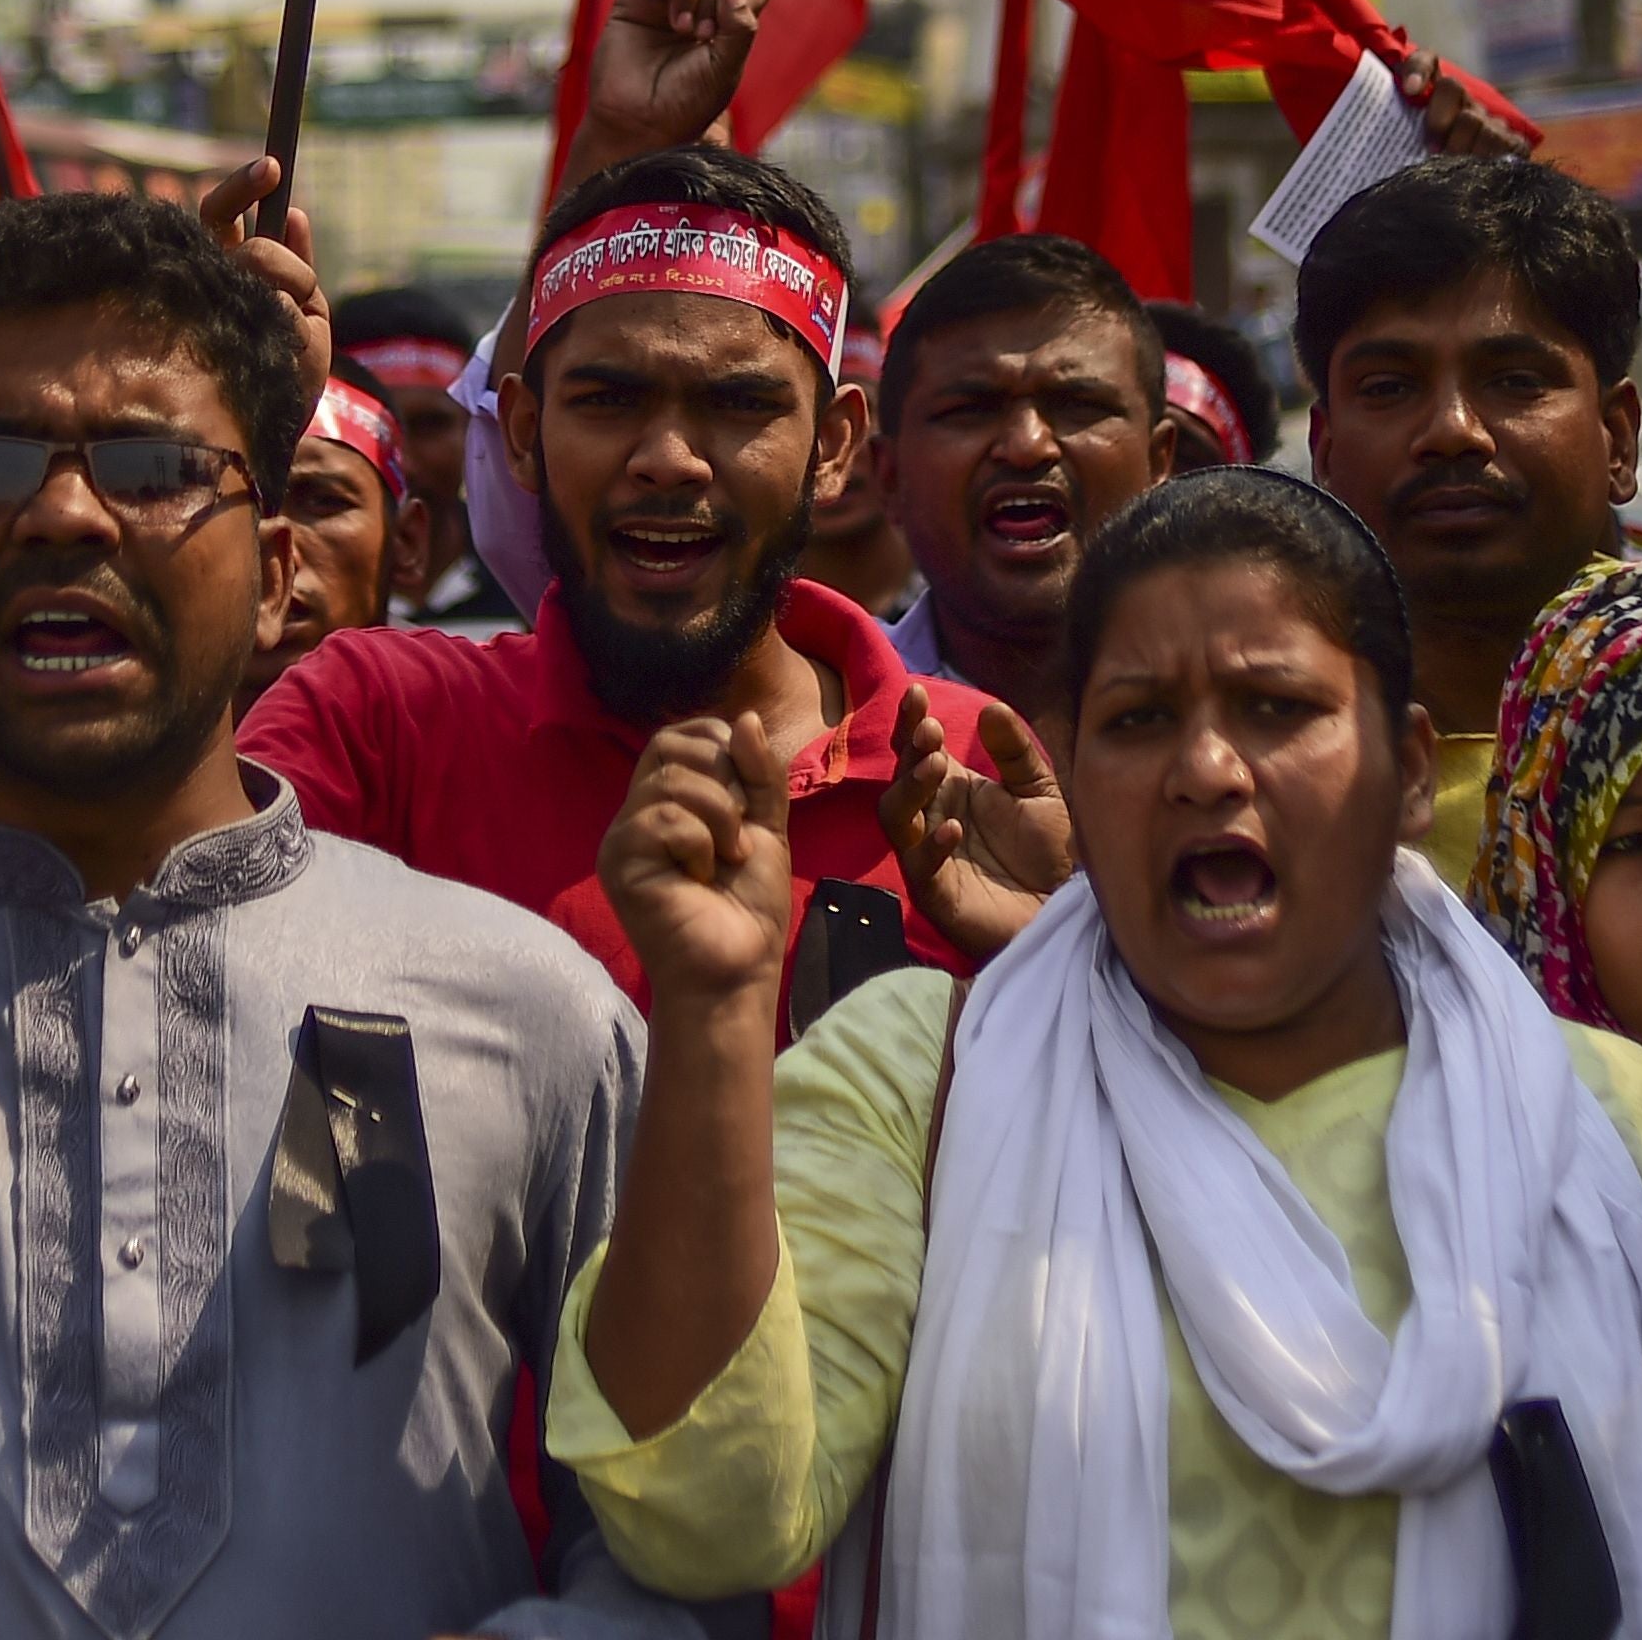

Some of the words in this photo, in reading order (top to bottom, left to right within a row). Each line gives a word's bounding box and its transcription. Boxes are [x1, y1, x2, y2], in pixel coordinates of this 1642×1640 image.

[599, 272, 626, 291] রেজি
[665, 267, 726, 290] বি-২১৮২
[608, 217, 663, 265] গার্মেন্টস
[663, 216, 708, 261] শ্রমিক
[709, 221, 761, 274] কর্মচারী
[762, 246, 815, 307] ফেডারেশন
